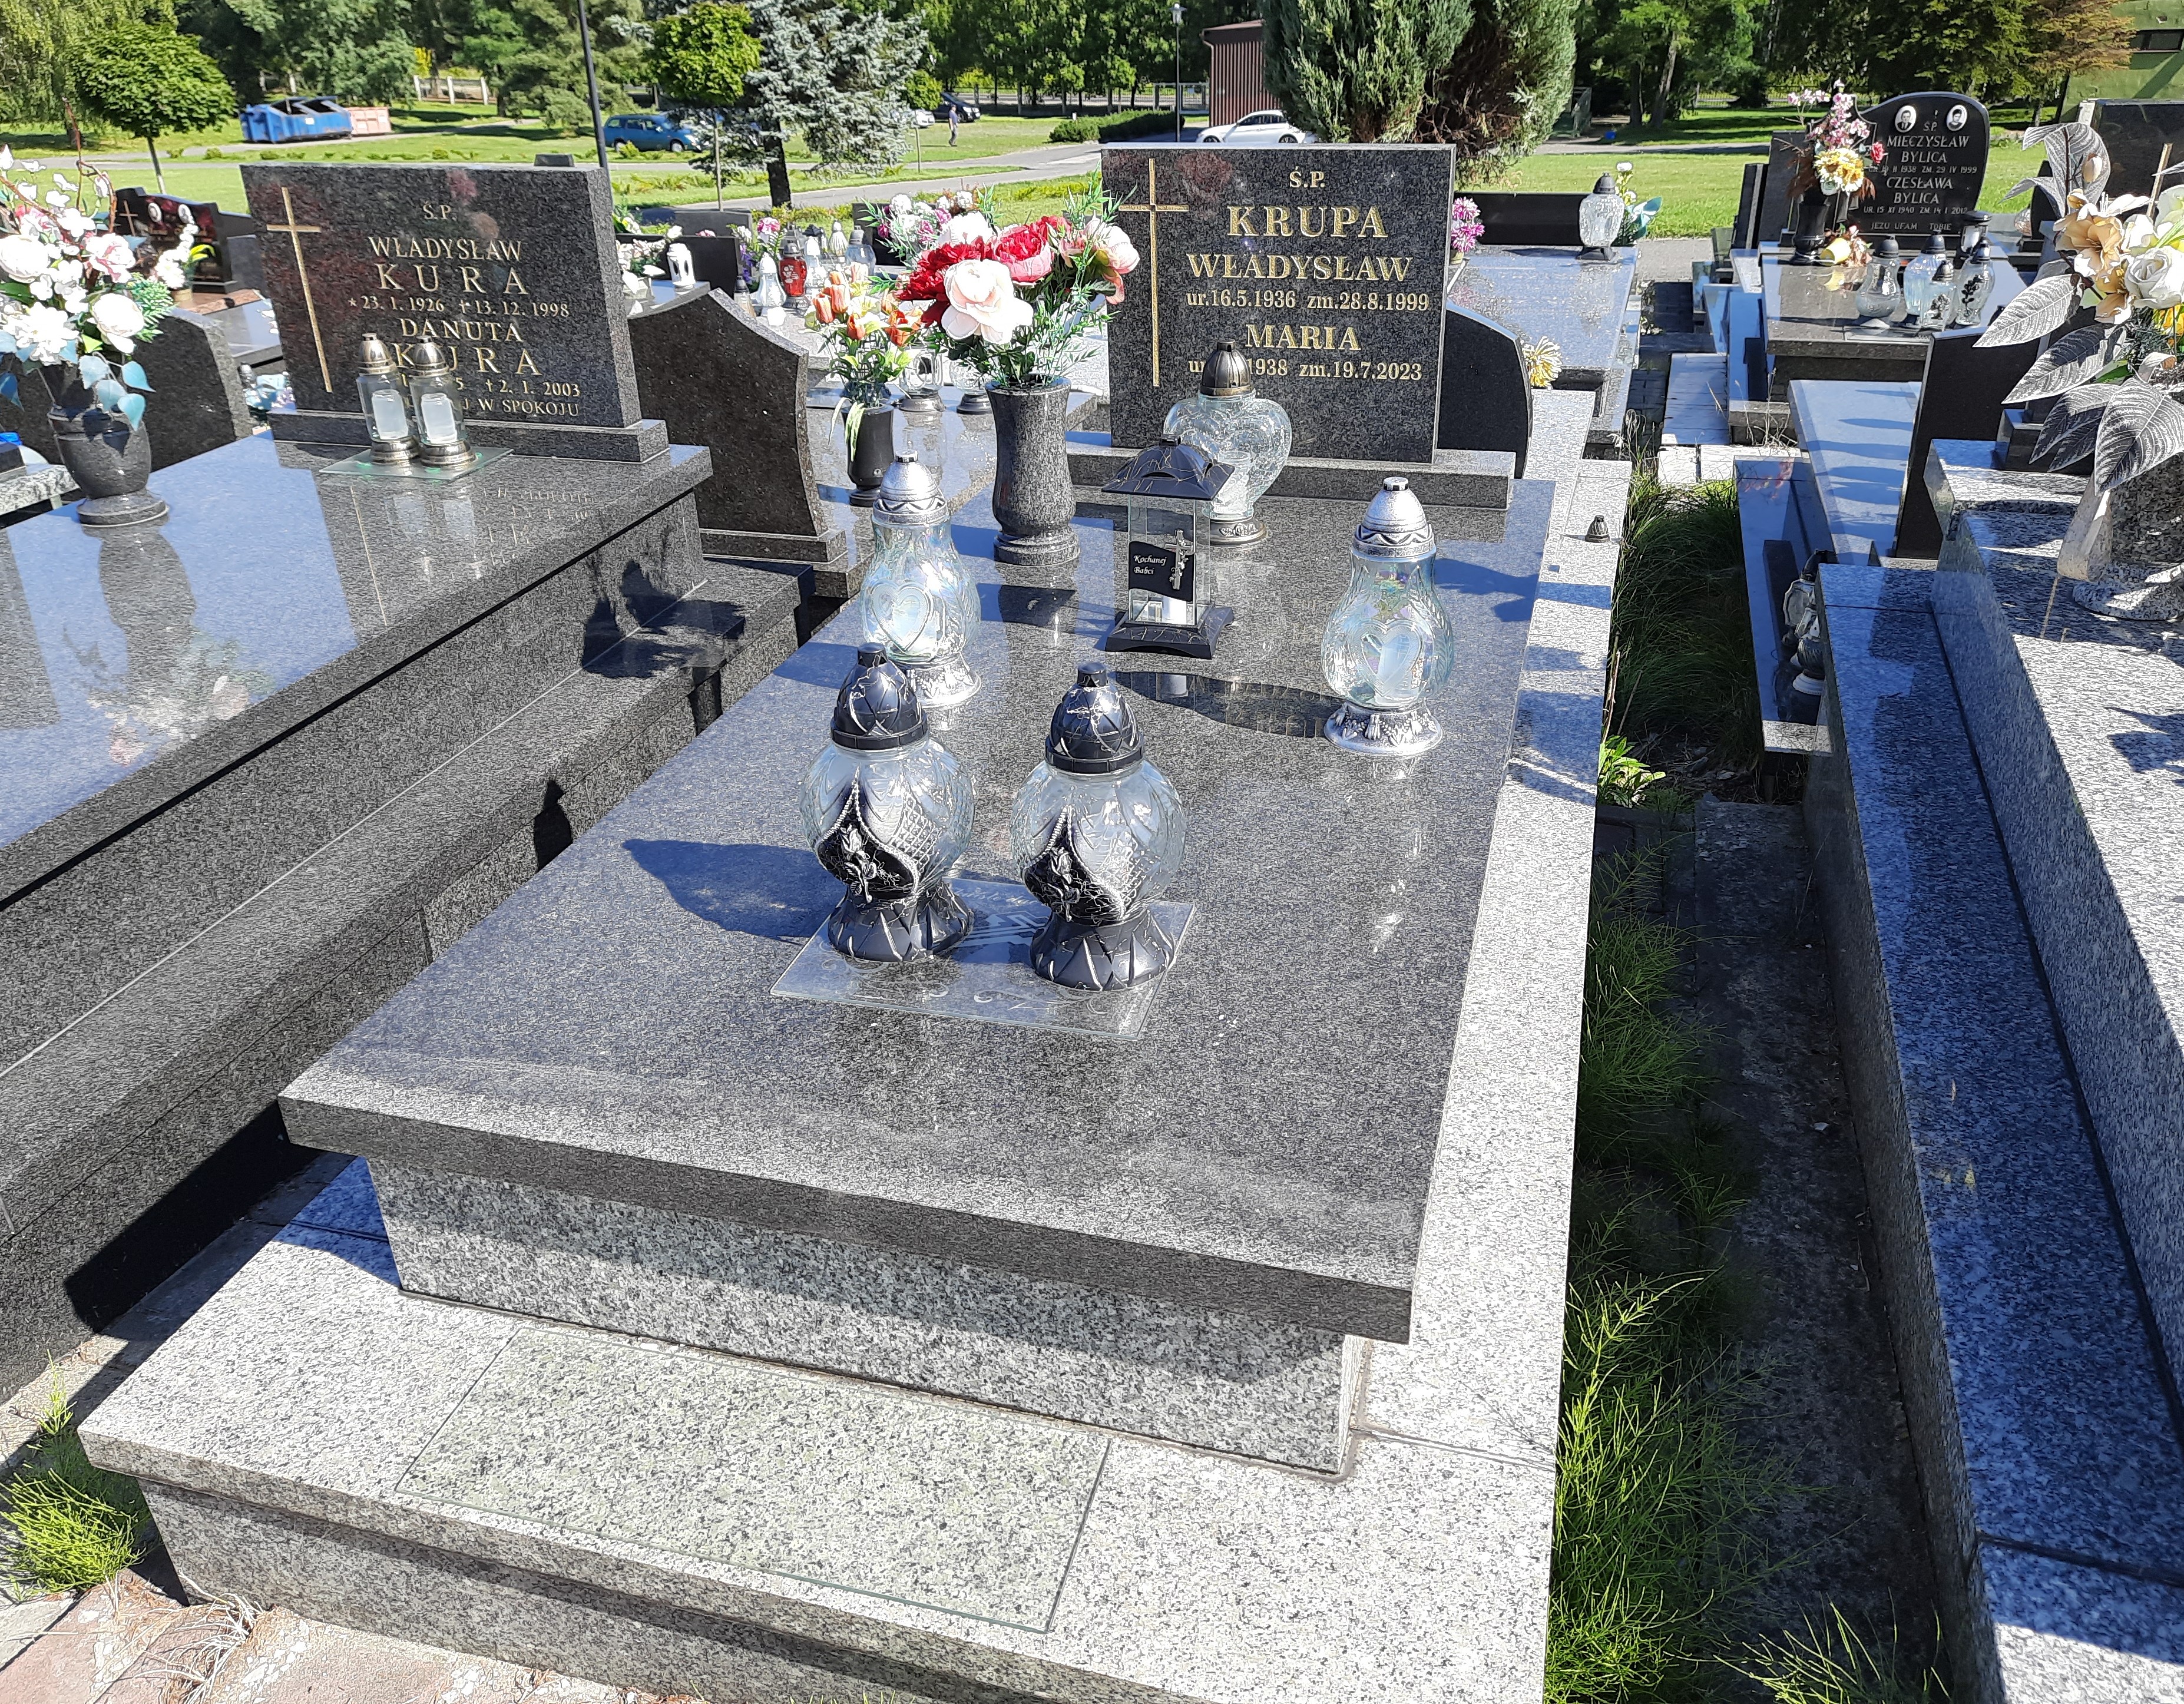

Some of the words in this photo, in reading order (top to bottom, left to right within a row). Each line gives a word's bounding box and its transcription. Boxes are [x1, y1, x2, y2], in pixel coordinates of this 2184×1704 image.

[1887, 135, 1970, 147] MIECZYSŁAW
[1901, 151, 1947, 163] BYLICA
[1289, 166, 1325, 188] Ś.P.
[1887, 177, 1954, 190] CZESŁAWA
[1894, 192, 1940, 204] BYLICA
[1227, 205, 1389, 239] KRUPA
[367, 236, 522, 261] WŁADYSŁAW
[1186, 253, 1413, 282] WŁADYSŁAW
[374, 263, 530, 295] KURA
[409, 297, 445, 313] 1926
[474, 300, 497, 315] 13.
[503, 301, 526, 316] 12.
[532, 302, 570, 318] 1998
[1186, 290, 1296, 308] ur.16.5.1936
[1306, 293, 1429, 312] zm.28.8.1999
[399, 318, 524, 342] DANUTA
[1245, 325, 1362, 351] MARIA
[1299, 361, 1422, 380] zm.19.7.2023
[544, 382, 581, 397] 2003
[478, 398, 495, 411] W
[502, 399, 580, 416] SPOKOJU
[1133, 555, 1167, 567] Kochanej
[1133, 567, 1155, 575] Babci
